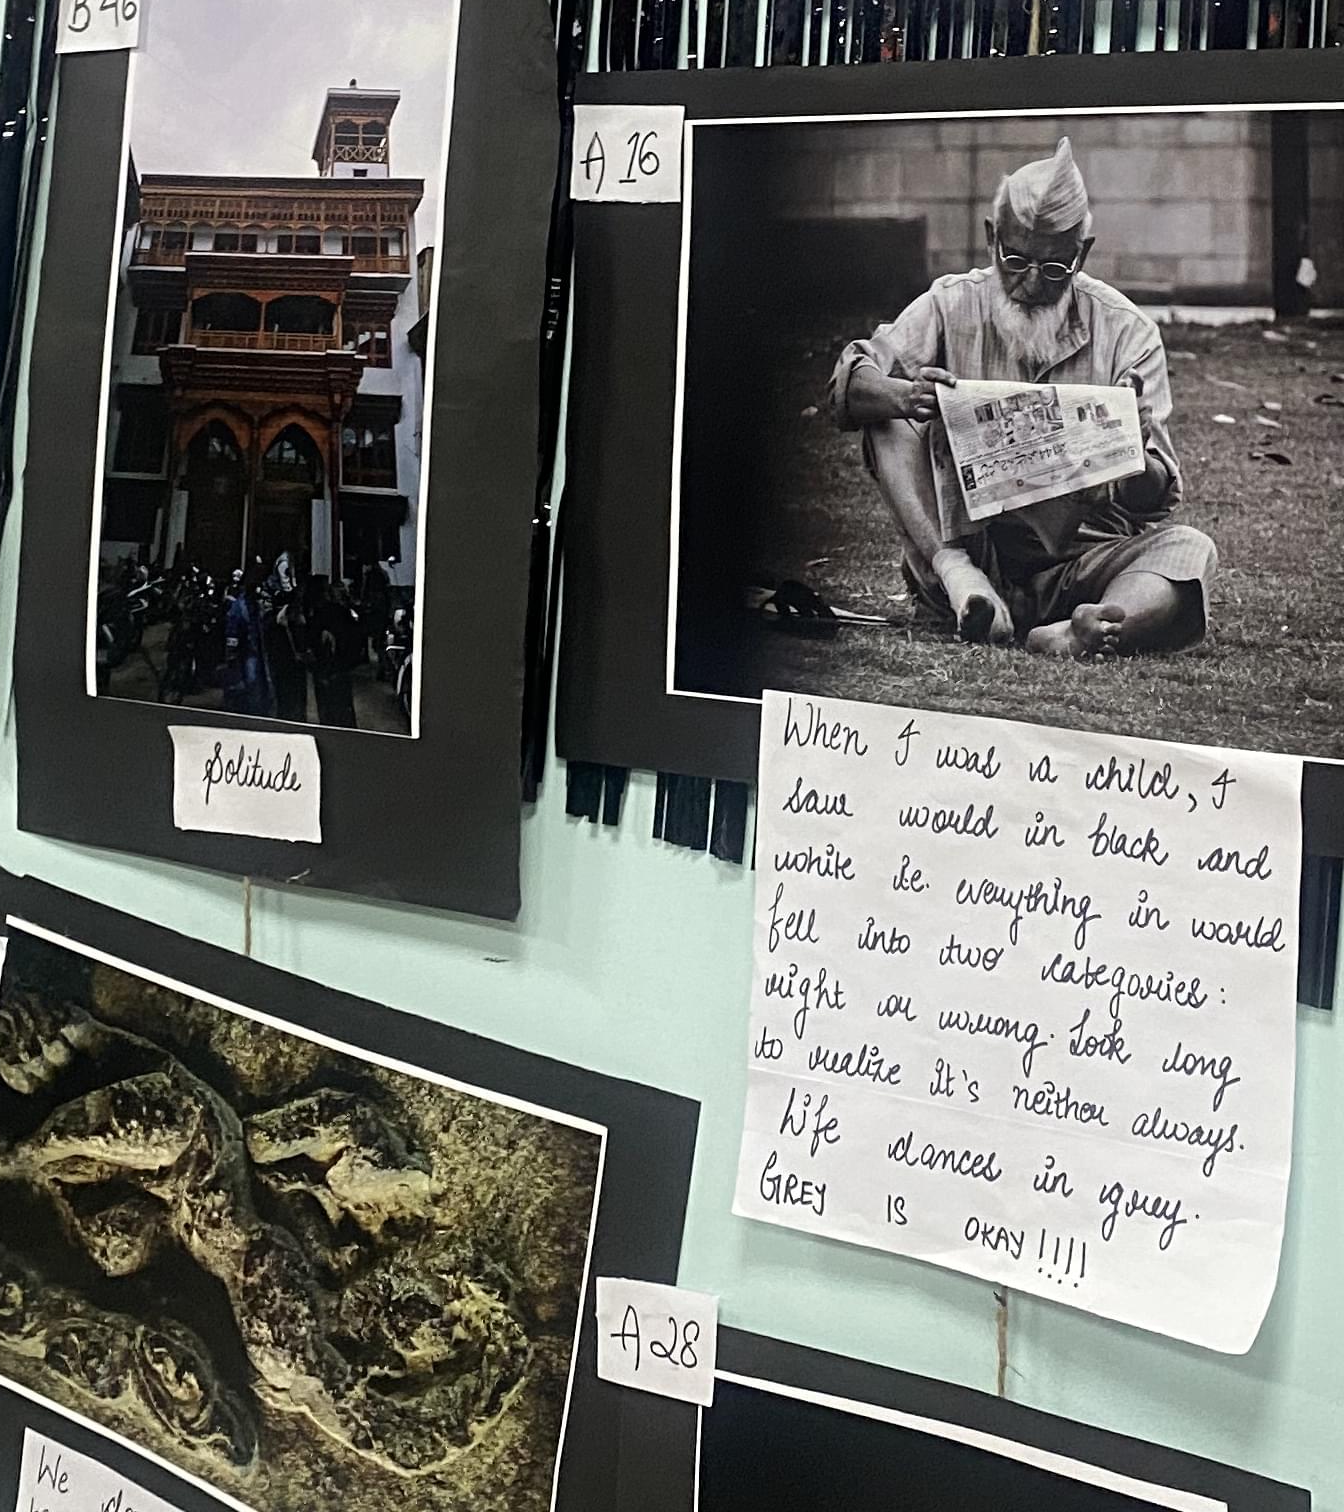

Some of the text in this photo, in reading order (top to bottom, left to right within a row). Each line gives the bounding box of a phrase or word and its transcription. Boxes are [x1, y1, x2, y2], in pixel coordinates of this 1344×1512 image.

[580, 131, 660, 194] A16
[203, 741, 302, 805] Solitude
[784, 697, 868, 756] When
[895, 719, 921, 766] I
[936, 746, 1001, 779] was
[1029, 755, 1058, 784] a
[1211, 768, 1237, 809] I
[782, 776, 1272, 880] saw in black and
[768, 882, 820, 953] fell
[857, 916, 911, 955] into
[939, 934, 1005, 971] two
[774, 844, 856, 881] white
[955, 876, 1102, 950] everything
[1128, 889, 1170, 931] in
[765, 963, 1241, 1113] right or wrong. long
[754, 1026, 1245, 1178] to realize it's neither always.
[779, 1087, 841, 1158] Life
[888, 1131, 1002, 1183] dances
[1032, 1155, 1074, 1198] in
[760, 1150, 908, 1226] GREY IS
[610, 1305, 700, 1371] A28
[37, 1445, 69, 1493] We
